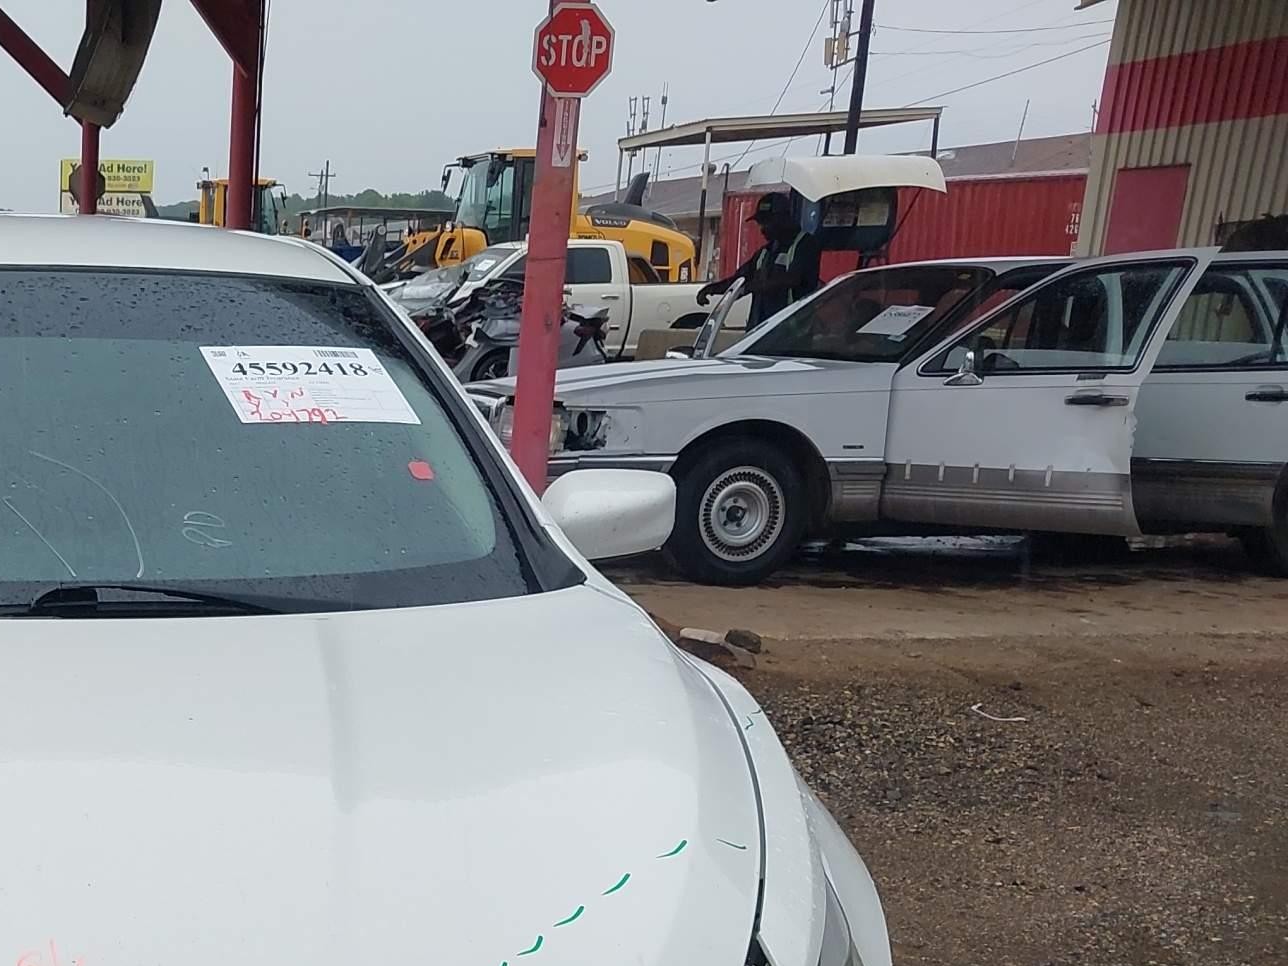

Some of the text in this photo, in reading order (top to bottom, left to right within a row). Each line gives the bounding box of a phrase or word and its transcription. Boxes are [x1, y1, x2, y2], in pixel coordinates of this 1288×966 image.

[540, 34, 607, 67] STOP
[99, 163, 147, 173] Ad Here!
[98, 197, 113, 206] Ad
[232, 362, 368, 376] 45592418
